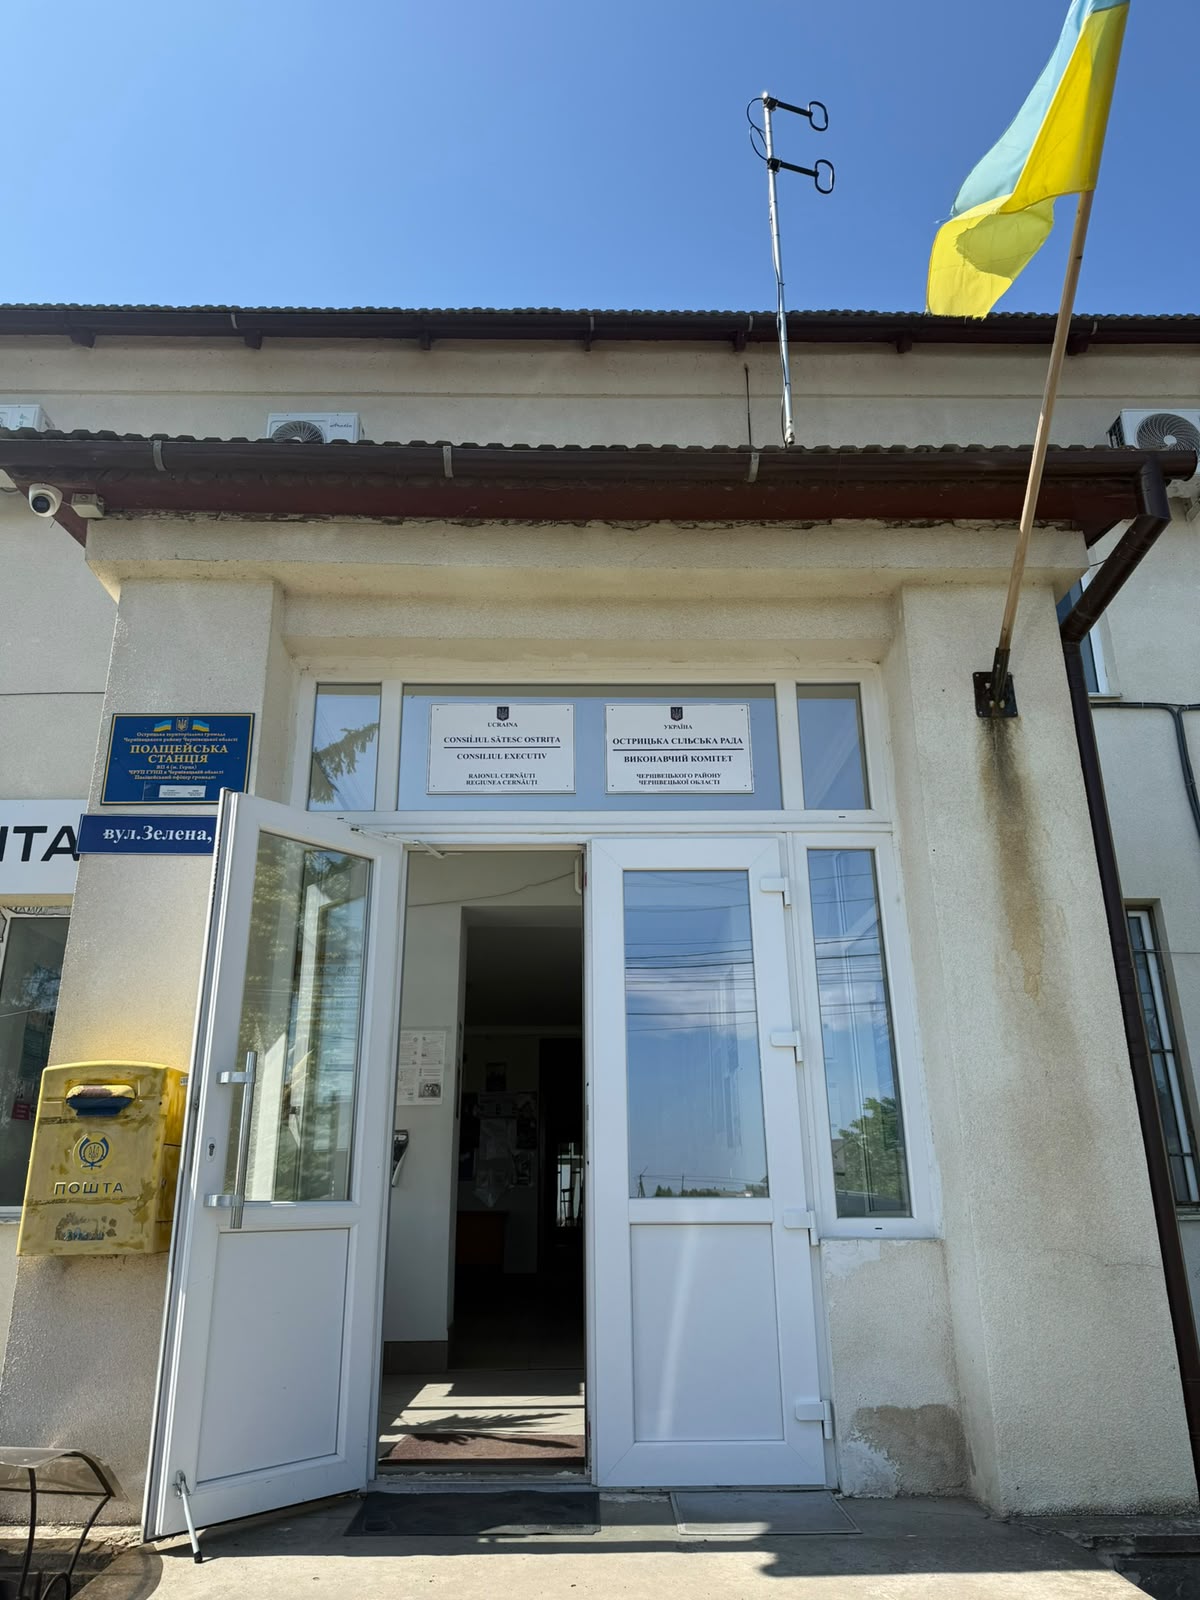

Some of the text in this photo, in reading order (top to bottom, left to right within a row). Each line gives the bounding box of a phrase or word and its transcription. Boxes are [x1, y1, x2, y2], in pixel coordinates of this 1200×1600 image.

[444, 735, 489, 743] CONSILIUL
[612, 737, 669, 745] ОСТРИЦЬКА
[130, 743, 228, 754] ПОЛІЦЕЙСЬКА
[148, 754, 208, 764] СТАНЦІЯ
[624, 754, 688, 763] ВИКОНАВЧИЙ
[103, 826, 212, 843] вул.Зелена,
[53, 1181, 123, 1195] ПОШТА
